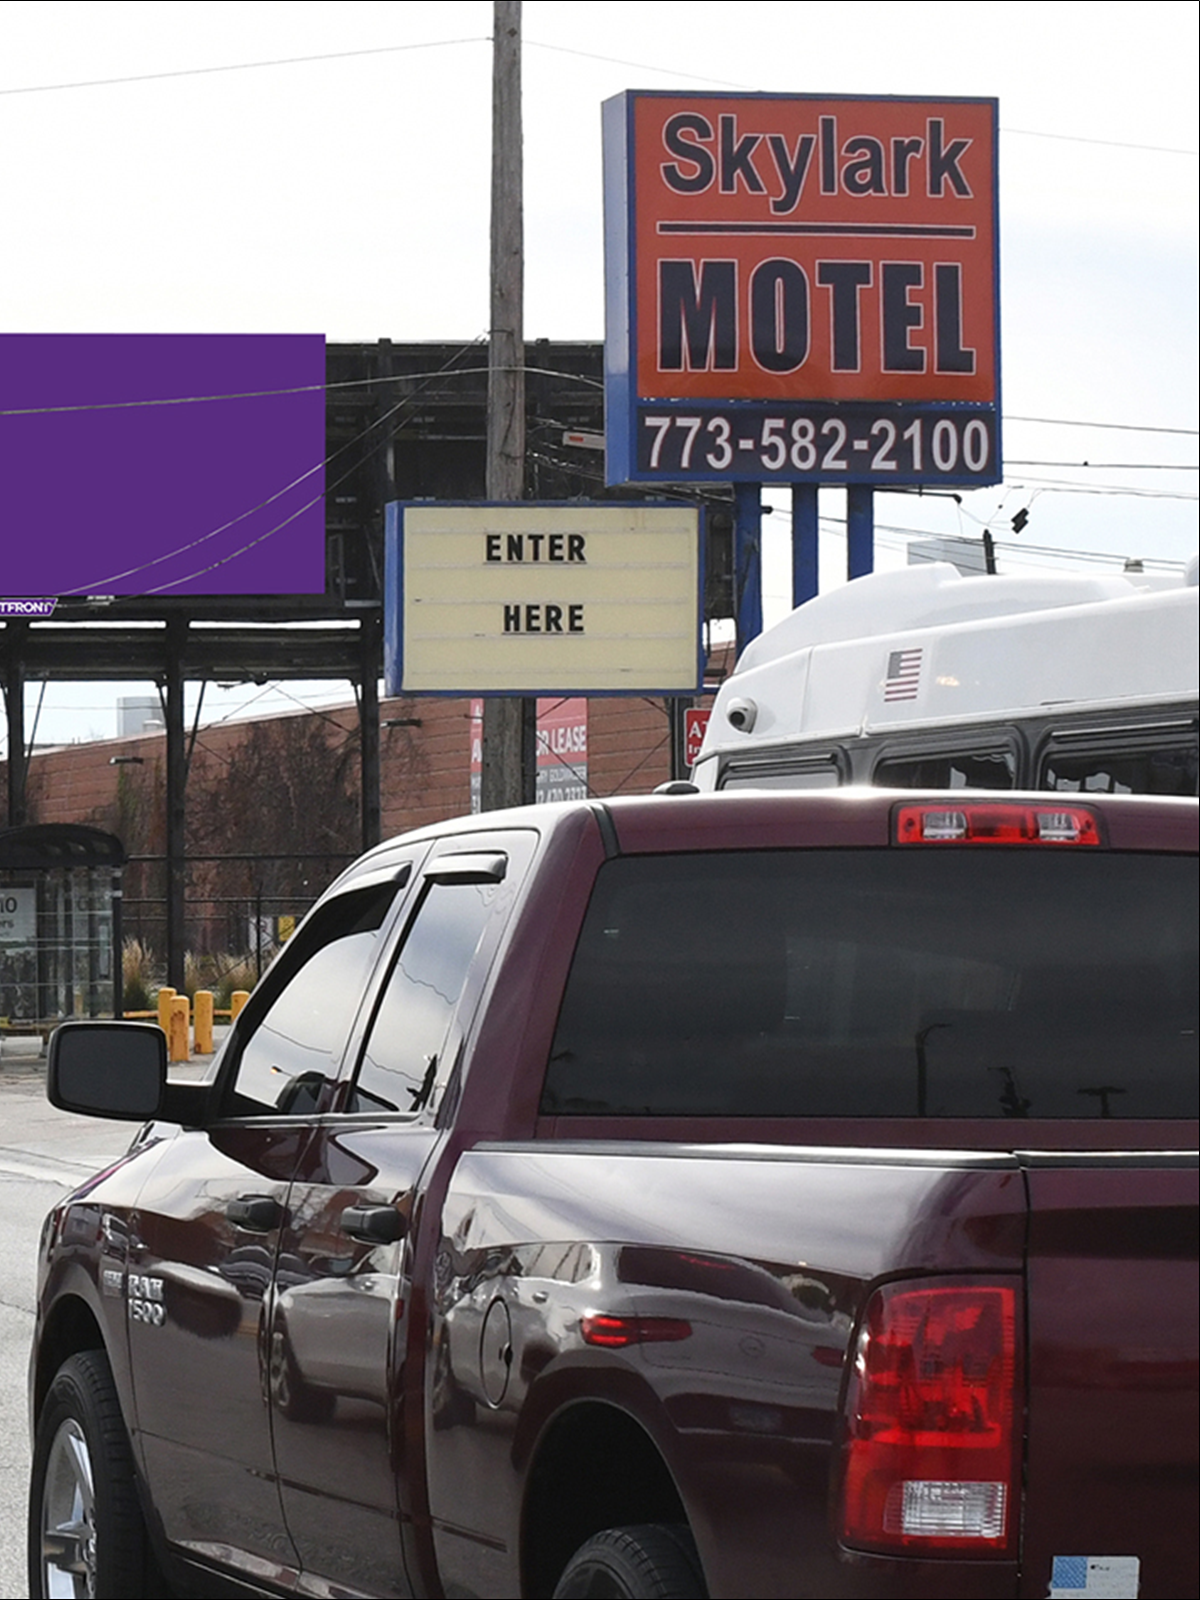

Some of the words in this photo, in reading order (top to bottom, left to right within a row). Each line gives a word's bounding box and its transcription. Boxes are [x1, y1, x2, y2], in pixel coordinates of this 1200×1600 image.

[659, 111, 974, 215] Skylark
[657, 257, 976, 375] MOTEL
[644, 416, 989, 472] 773-582-2100
[485, 533, 587, 563] ENTER
[502, 604, 585, 633] HERE
[551, 725, 586, 753] LEASE
